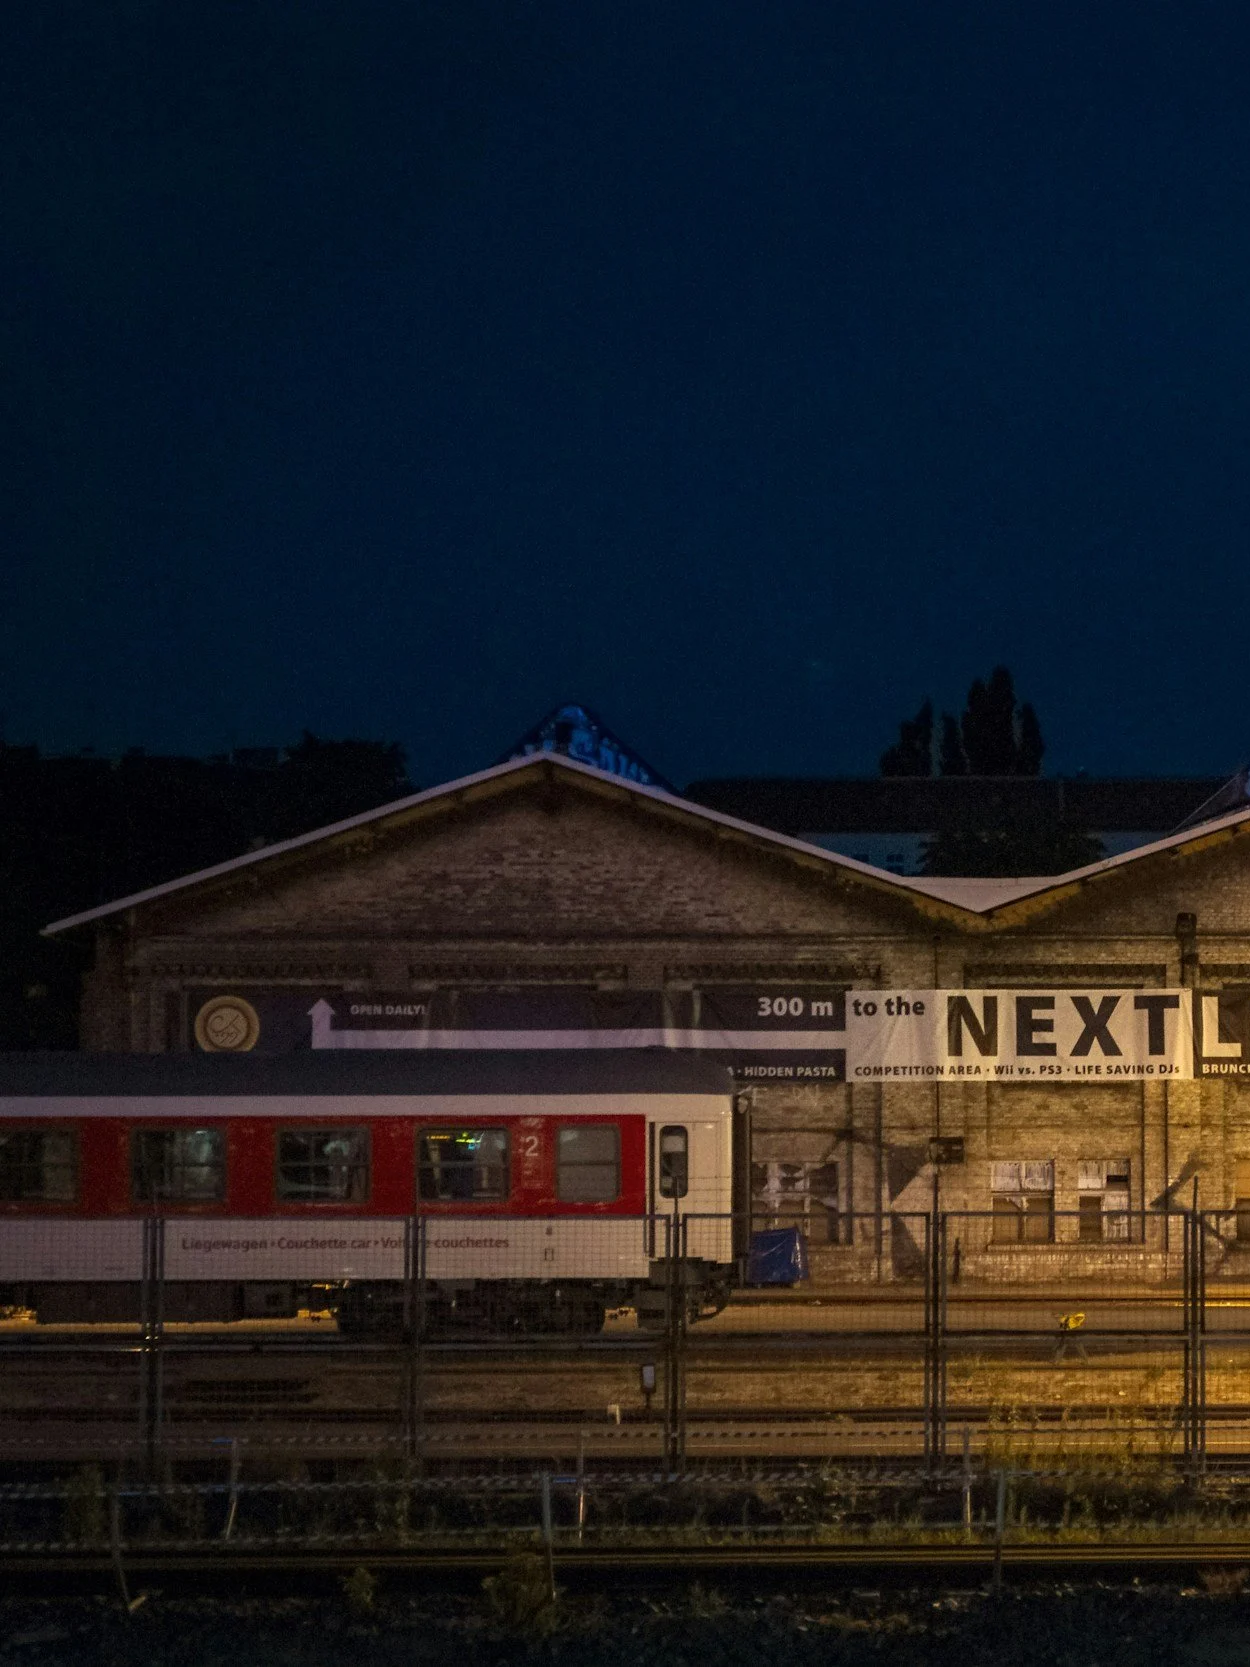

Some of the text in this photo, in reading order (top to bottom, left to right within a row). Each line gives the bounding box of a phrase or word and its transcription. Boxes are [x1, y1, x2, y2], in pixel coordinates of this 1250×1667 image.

[350, 1004, 426, 1015] OPEN DAILY!
[757, 996, 834, 1017] 300 m
[852, 998, 878, 1017] to
[884, 996, 925, 1016] the
[947, 994, 1180, 1056] NEXT
[744, 1066, 793, 1077] HIDDEN
[796, 1066, 836, 1077] PASTA
[854, 1064, 1180, 1077] COMPETITION AREA Wii vs. PS3 LIFE SAVING DJs
[525, 1135, 539, 1157] 2
[181, 1238, 268, 1252] Liegewagen
[277, 1236, 348, 1249] Couchette
[351, 1238, 370, 1249] car
